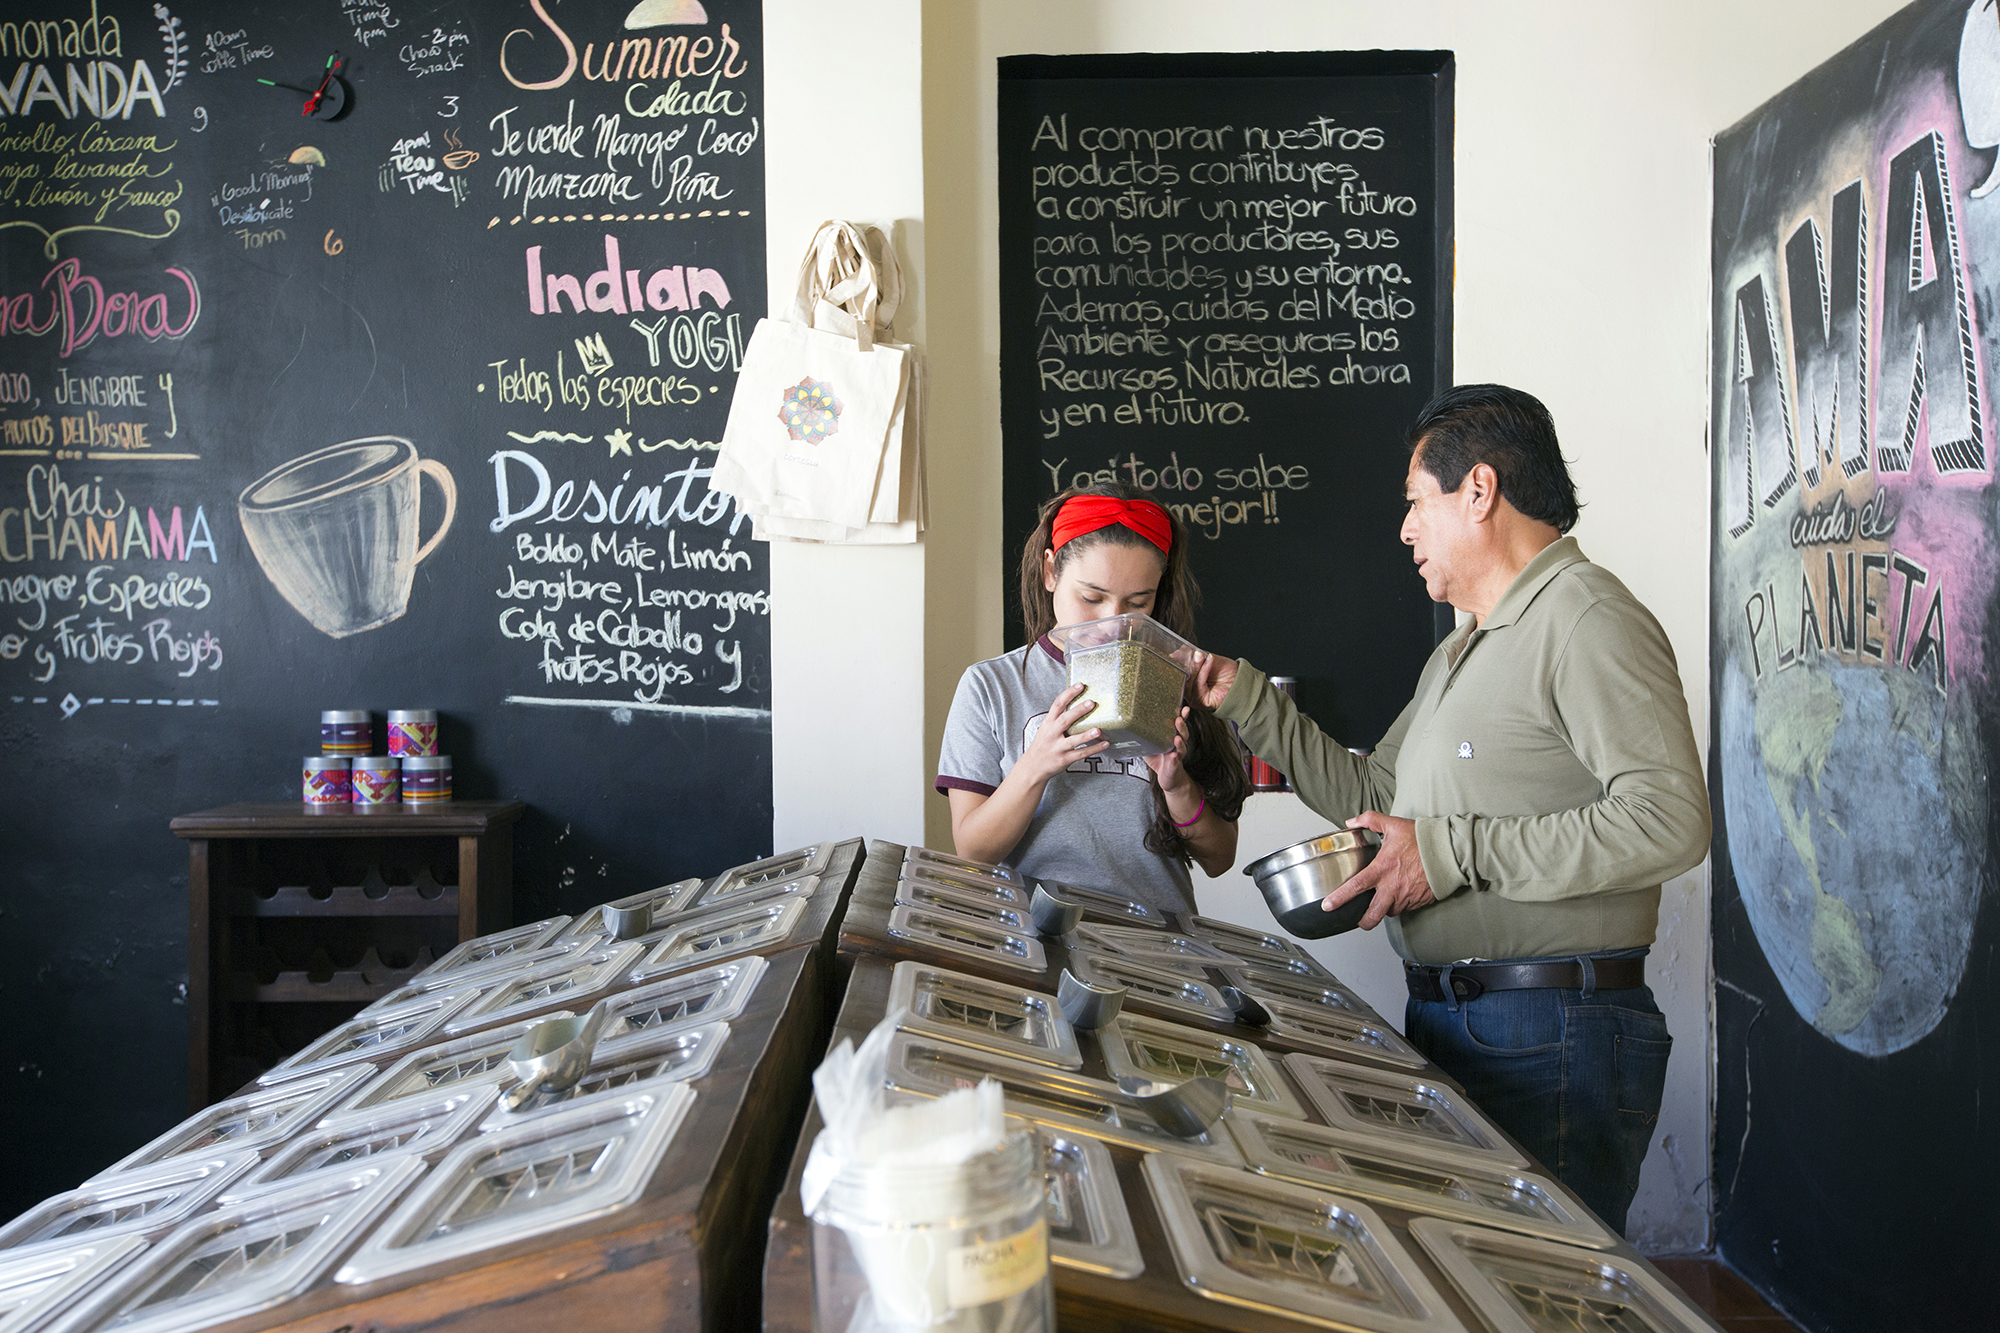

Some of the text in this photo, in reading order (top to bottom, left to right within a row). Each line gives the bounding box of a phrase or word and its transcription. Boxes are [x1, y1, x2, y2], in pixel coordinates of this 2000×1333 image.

[231, 41, 275, 66] Time
[500, 0, 748, 91] Summer
[0, 59, 166, 120] VANDA
[437, 95, 460, 118] 3
[624, 71, 747, 118] Colada
[190, 106, 208, 132] 9
[527, 99, 584, 158] verde
[592, 114, 688, 188] Mango
[697, 117, 759, 156] Coco
[1032, 113, 1385, 165] Al comprar nuestros
[496, 165, 643, 219] Manzana
[659, 154, 734, 206] Piña
[1033, 150, 1359, 202] productos contribuyes
[1036, 180, 1417, 232] a construir un mejor futuro
[323, 228, 344, 256] 6
[1033, 220, 1400, 268] para los productores, sus
[526, 234, 732, 315] Indian
[1034, 254, 1227, 290] comunidades
[1235, 269, 1253, 297] y
[1256, 263, 1290, 287] su
[41, 257, 200, 358] Bora
[1035, 283, 1416, 328] Además, cuidas del Medio
[1037, 322, 1172, 359] Ambiente
[1203, 329, 1356, 366] aseguras
[1359, 323, 1400, 352] los
[1727, 128, 1987, 540] AMA
[55, 367, 149, 407] JENGIBRE
[487, 350, 702, 425] Todas las especies
[1038, 353, 1411, 392] Recursos Naturales ahora
[1063, 402, 1106, 427] en
[1114, 393, 1142, 426] el
[1144, 389, 1250, 426] futuro.
[27, 463, 125, 521] Chai
[1122, 451, 1203, 491] todo
[1214, 453, 1310, 490] sabe
[0, 506, 218, 563] CHAMAMA
[1792, 486, 1896, 546] cuida el
[86, 565, 212, 621] Especies
[53, 613, 144, 665] Frutos
[499, 606, 560, 642] Cola
[567, 612, 596, 645] de
[596, 608, 703, 656] Caballo
[1744, 549, 1948, 697] PLANETA
[618, 650, 693, 705] Rojos
